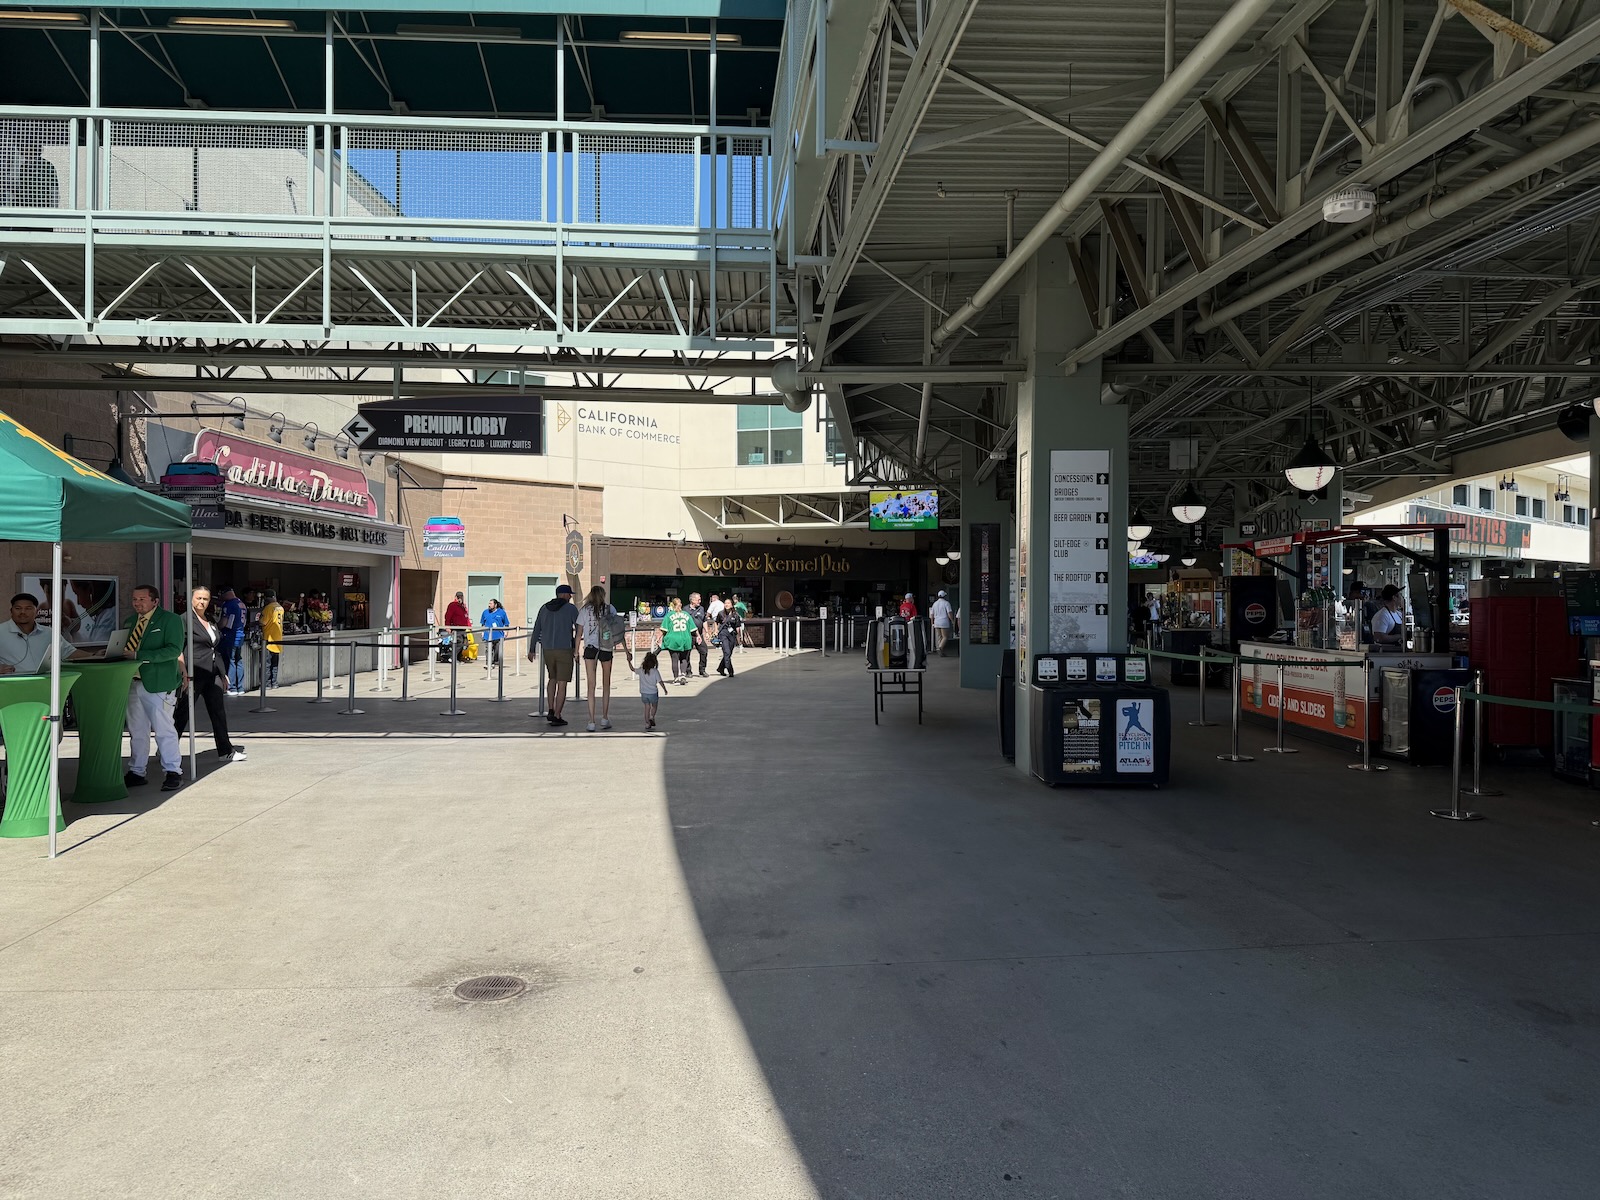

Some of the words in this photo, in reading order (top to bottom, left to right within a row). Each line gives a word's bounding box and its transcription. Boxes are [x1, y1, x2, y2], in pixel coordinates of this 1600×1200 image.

[577, 407, 658, 428] CALIFORNIA
[403, 414, 464, 435] PREMIUM
[466, 415, 507, 436] LOBBY
[578, 423, 606, 435] BANK
[609, 427, 623, 437] OF
[626, 429, 681, 444] COMMERCE
[378, 437, 405, 446] DIAMOND
[405, 437, 420, 447] VIEW
[420, 437, 444, 447] DUGOUT
[448, 438, 470, 448] LEGACY
[470, 439, 485, 448] CLUB
[489, 439, 511, 449] LUXURY
[511, 440, 532, 449] SUITES
[1054, 475, 1094, 483] CONCESSIONS
[1054, 487, 1079, 496] BRIDGES
[1053, 513, 1068, 522] BEER
[1069, 513, 1092, 522] GARDEN
[250, 512, 286, 533] BEER
[341, 526, 360, 542] HOT
[1053, 539, 1081, 548] GILT-EDGE
[1053, 550, 1068, 558] CLUB
[698, 549, 743, 574] Coop
[746, 555, 761, 571] &
[763, 552, 818, 573] Kennel
[819, 553, 850, 577] Pub
[1053, 573, 1064, 581] THE
[1065, 573, 1092, 581] ROOFTOP
[1053, 605, 1088, 613] RESTROOMS
[673, 619, 687, 632] 26
[1268, 694, 1286, 710] CIDES
[1287, 698, 1299, 713] AND
[1300, 700, 1326, 719] SLIDERS
[1119, 741, 1141, 750] PITCH
[1142, 741, 1151, 750] IN
